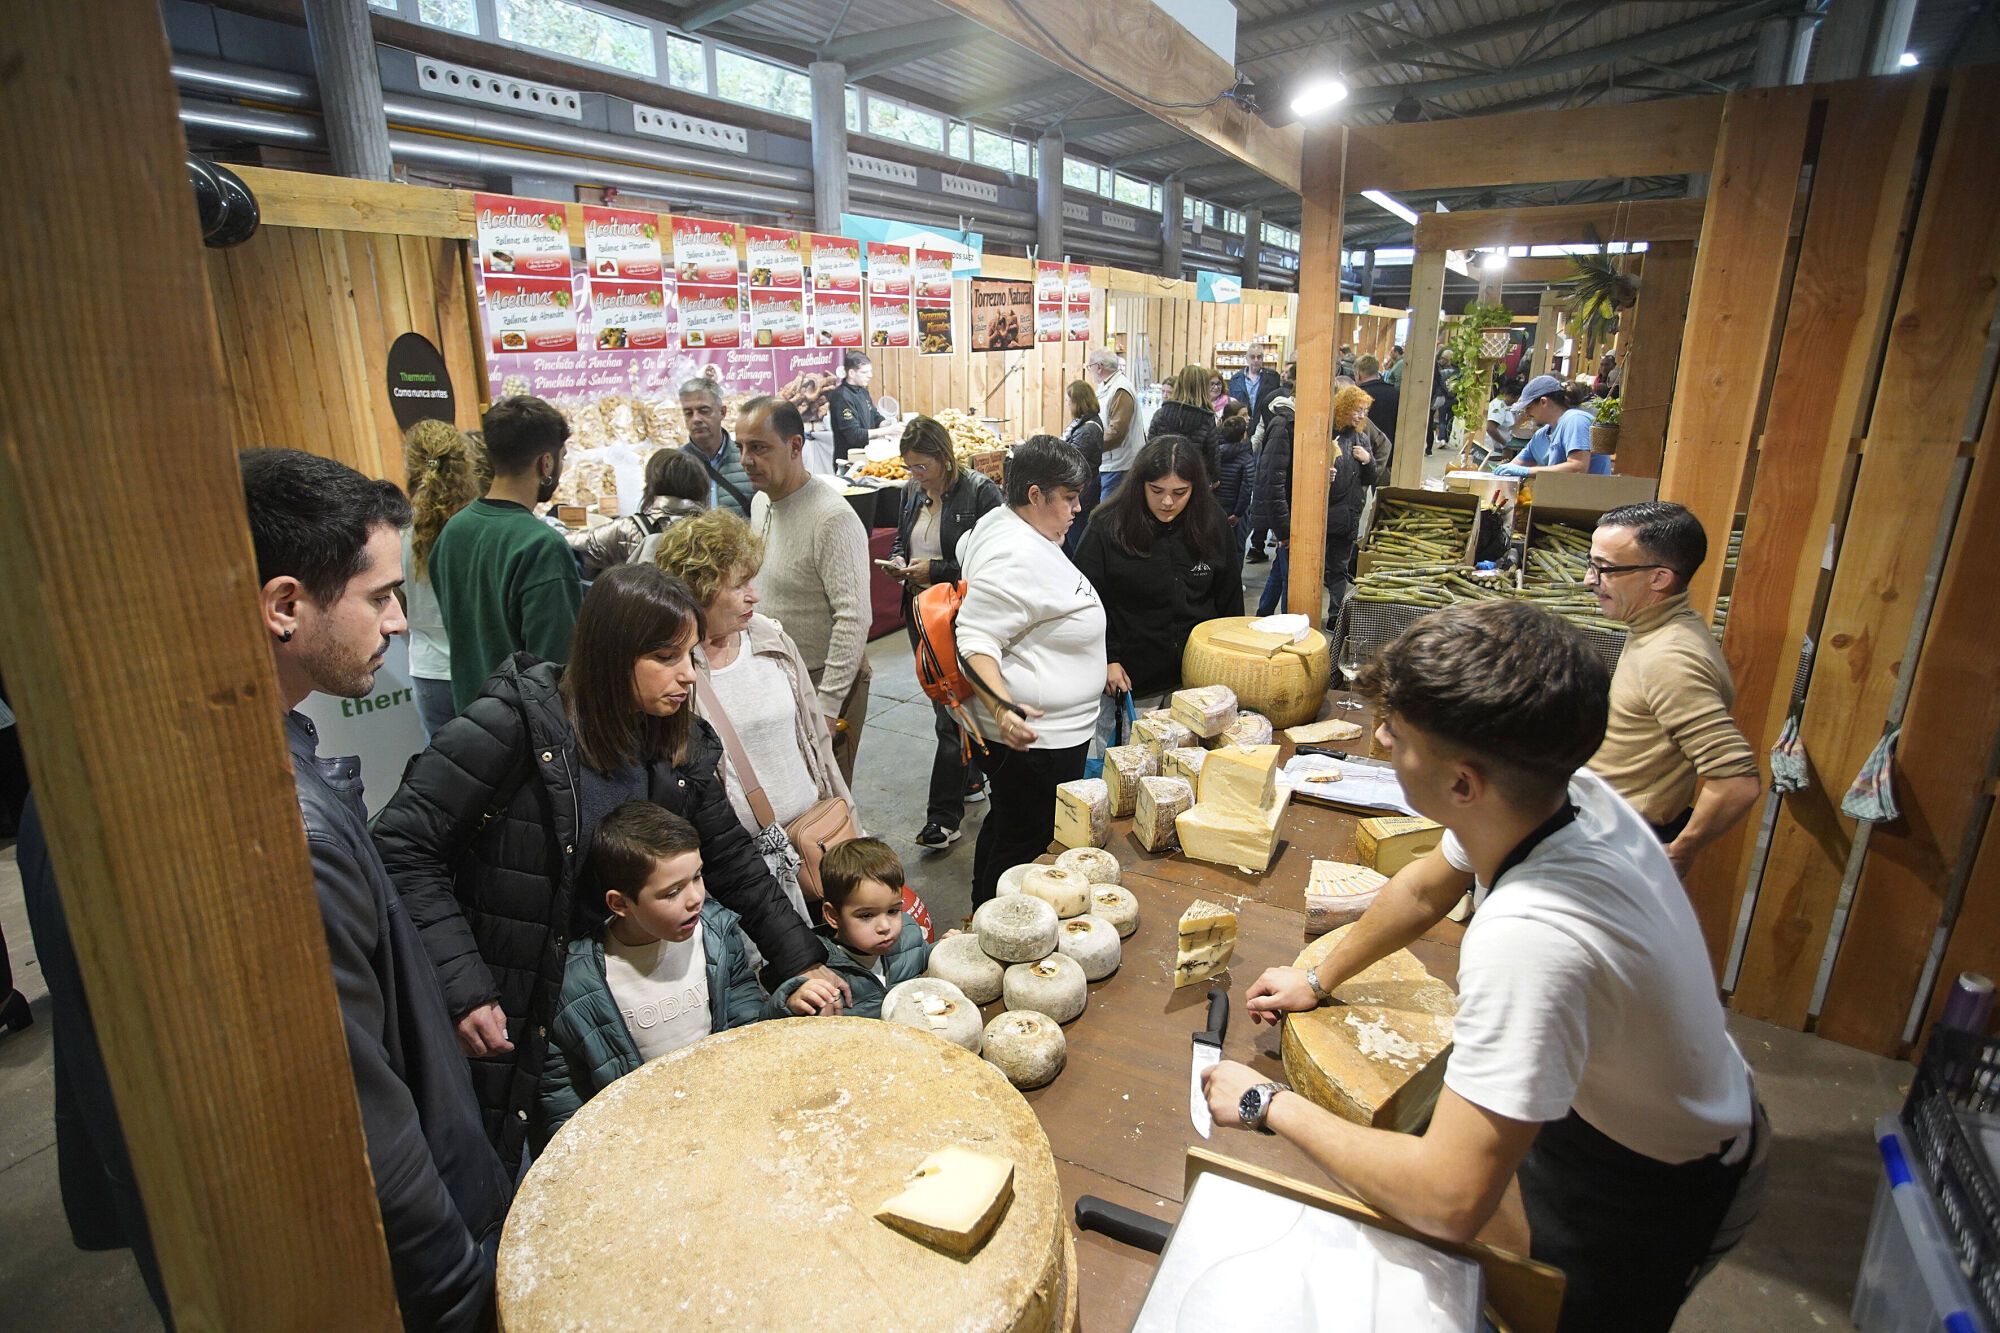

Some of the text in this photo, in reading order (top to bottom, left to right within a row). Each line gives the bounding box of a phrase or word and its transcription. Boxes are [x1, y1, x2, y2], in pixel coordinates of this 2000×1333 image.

[481, 206, 545, 230] Aceitunas
[588, 216, 642, 239] Aceitunas
[676, 225, 721, 246] Aceitunas
[749, 233, 788, 252] Aceitunas
[814, 241, 849, 259] Aceitunas
[490, 286, 553, 311] Aceitunas
[594, 288, 648, 311] Aceitunas
[680, 292, 725, 313] Aceitunas
[752, 296, 792, 316] Aceitunas
[974, 287, 1031, 308] Torrezno Natural
[815, 299, 850, 317] Aceitunas
[533, 353, 623, 371] Pinchito de Anchoa
[727, 350, 769, 368] Berenjenas
[534, 370, 623, 389] Pinchito de Salmón
[725, 365, 772, 385] de Almagro
[394, 387, 411, 397] Como
